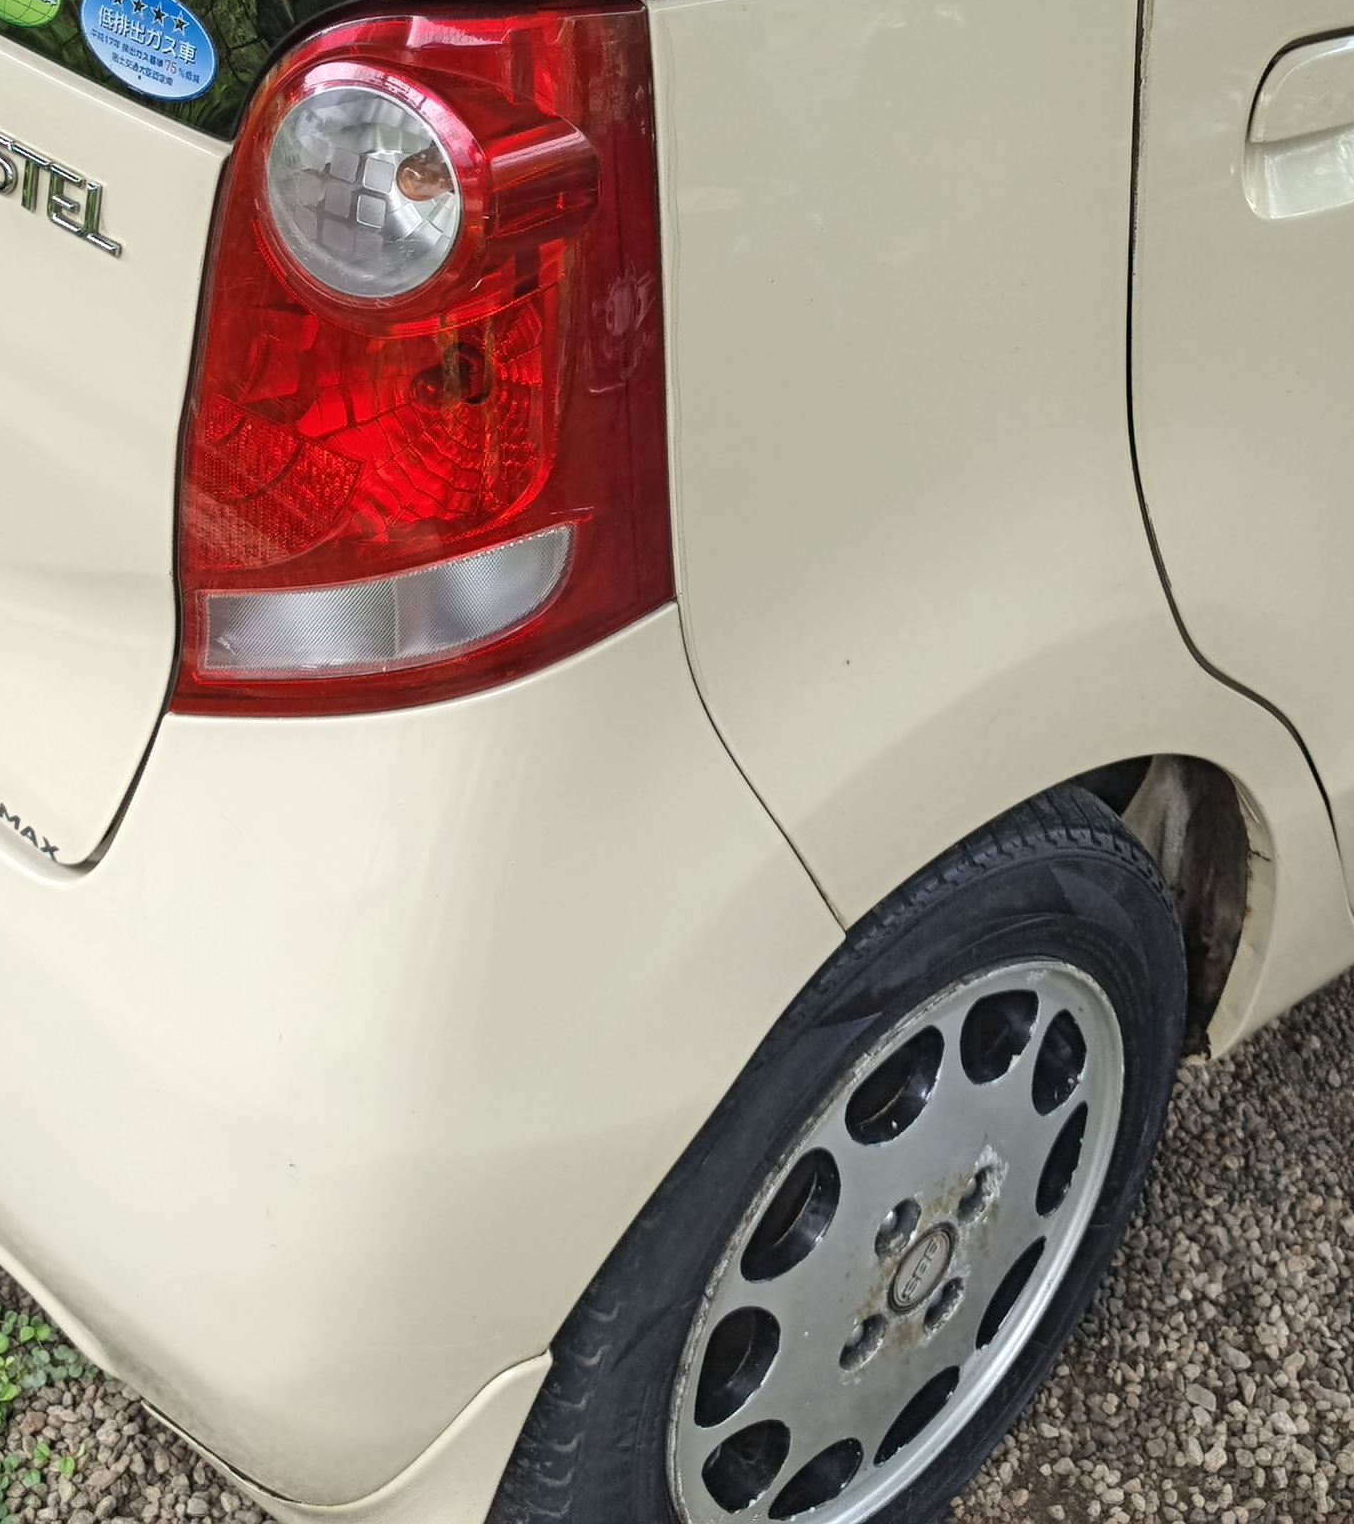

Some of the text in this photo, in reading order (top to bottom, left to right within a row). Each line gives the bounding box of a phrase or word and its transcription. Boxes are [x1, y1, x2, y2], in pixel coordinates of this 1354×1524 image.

[98, 4, 197, 64] 低排出ガス車
